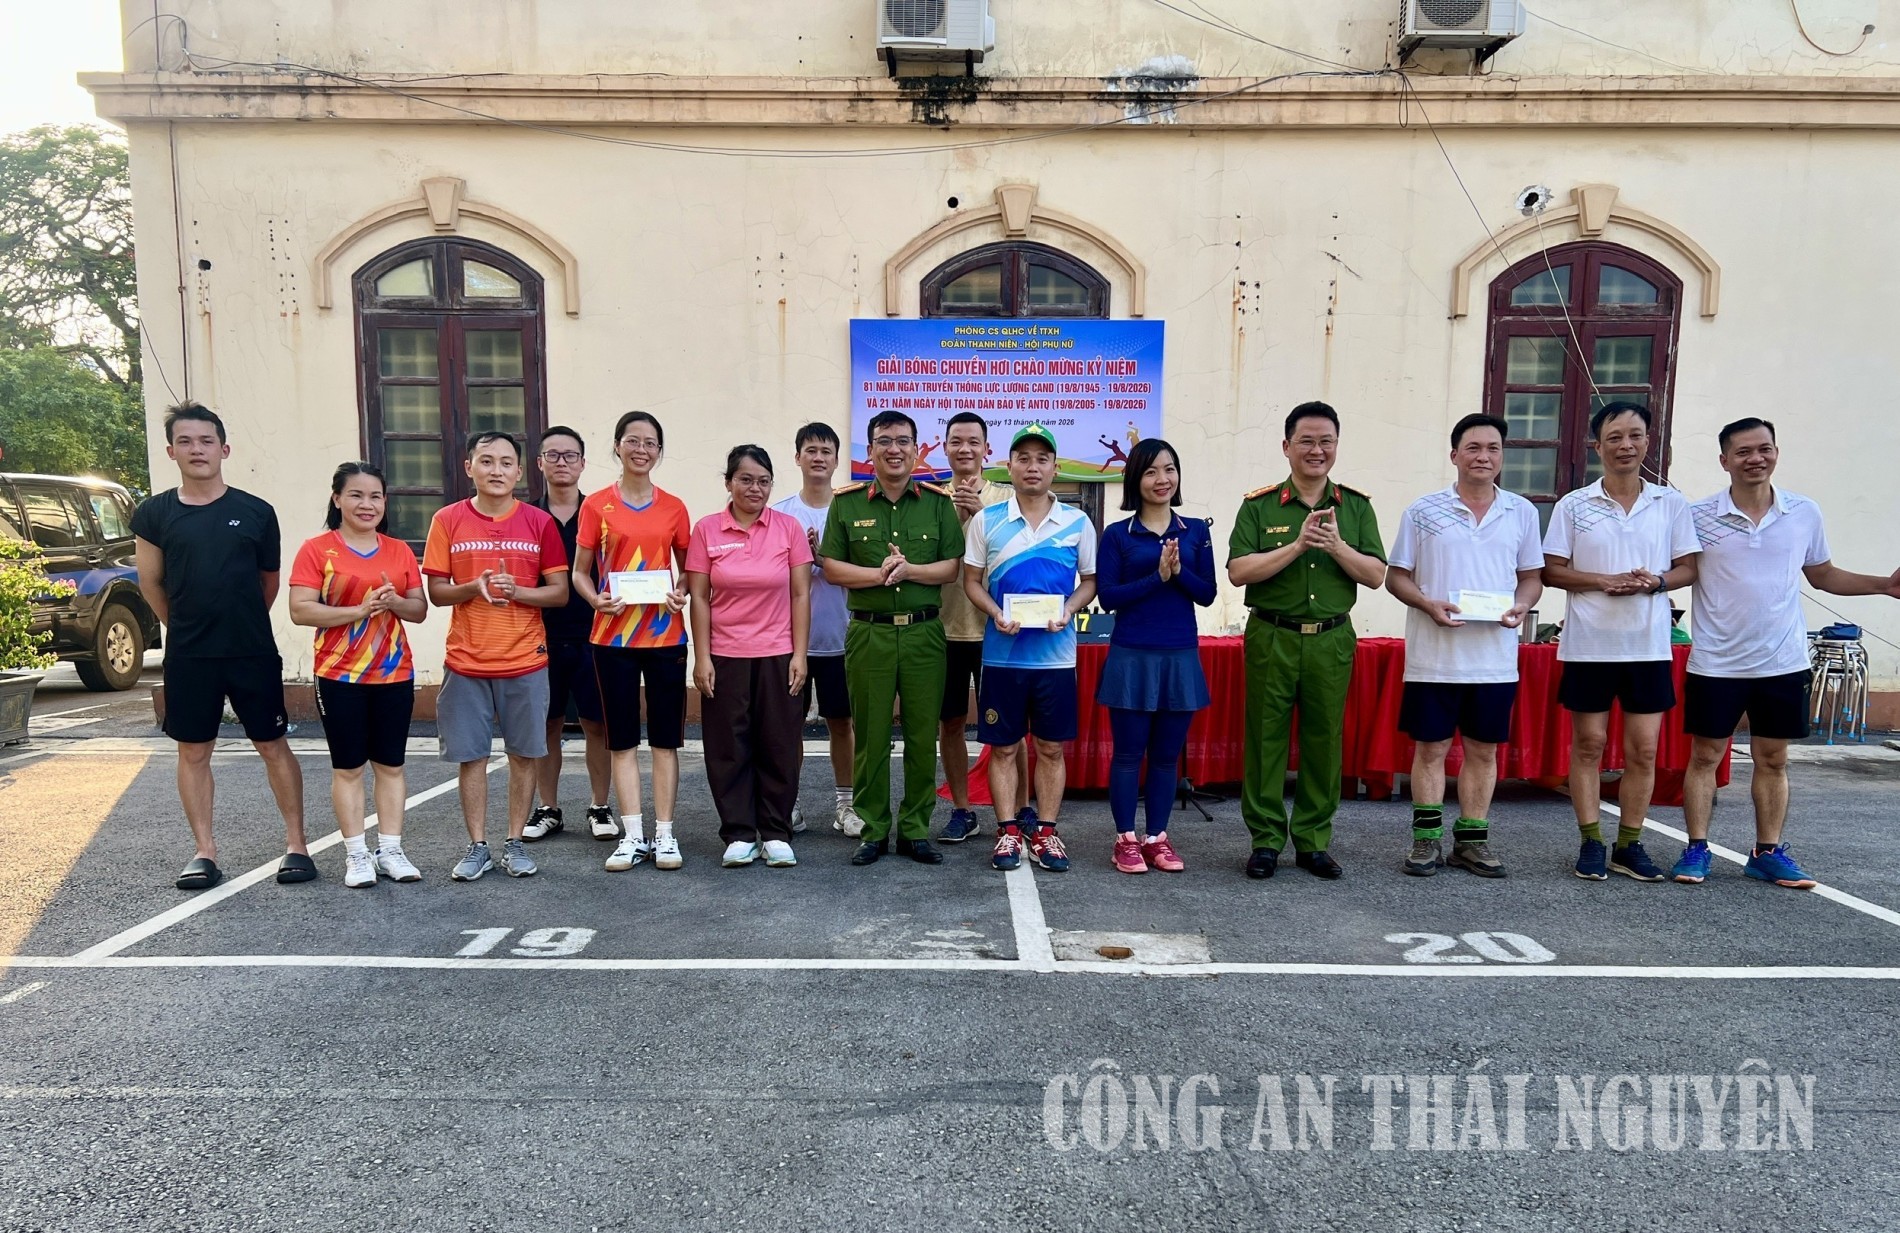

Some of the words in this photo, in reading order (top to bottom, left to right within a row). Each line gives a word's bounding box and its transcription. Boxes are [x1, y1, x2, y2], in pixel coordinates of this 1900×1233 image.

[954, 326, 985, 335] PHÒNG
[1001, 328, 1024, 336] QLHC
[941, 339, 966, 348] ĐOÀN
[999, 339, 1018, 348] NIÊN
[1025, 339, 1039, 350] HỘI
[1042, 341, 1059, 350] PHỤ
[1062, 339, 1074, 348] NỮ
[877, 355, 901, 375] GIẢI
[904, 356, 937, 375] BÓNG
[990, 359, 1010, 376] HƠI
[1013, 357, 1045, 376] CHÀO
[1048, 357, 1083, 376] MỪNG
[1087, 356, 1103, 376] KỶ
[1105, 357, 1136, 379] NIỆM
[863, 382, 873, 392] 81
[876, 380, 895, 392] NĂM
[898, 380, 920, 392] NGÀY
[956, 379, 982, 393] THỐNG
[985, 382, 1000, 395] LỰC
[1002, 382, 1029, 395] LƯỢNG
[1032, 383, 1054, 393] CAND
[1056, 383, 1100, 394] (19/8/1945
[1108, 383, 1151, 394] 19/8/2026)
[867, 396, 878, 408] VÀ
[880, 398, 889, 408] 21
[892, 397, 911, 409] NĂM
[913, 396, 935, 409] NGÀY
[938, 397, 952, 411] HỘI
[954, 397, 976, 409] TOÀN
[978, 397, 995, 409] DÂN
[997, 396, 1013, 410] BẢO
[1016, 397, 1026, 411] VỆ
[1028, 399, 1049, 410] ANTQ
[1052, 399, 1095, 410] (19/8/2005
[1103, 399, 1146, 410] 19/8/2026)
[986, 419, 1002, 427] ngày
[1058, 418, 1075, 426] 2026
[454, 927, 598, 957] 19
[1383, 931, 1557, 963] 20
